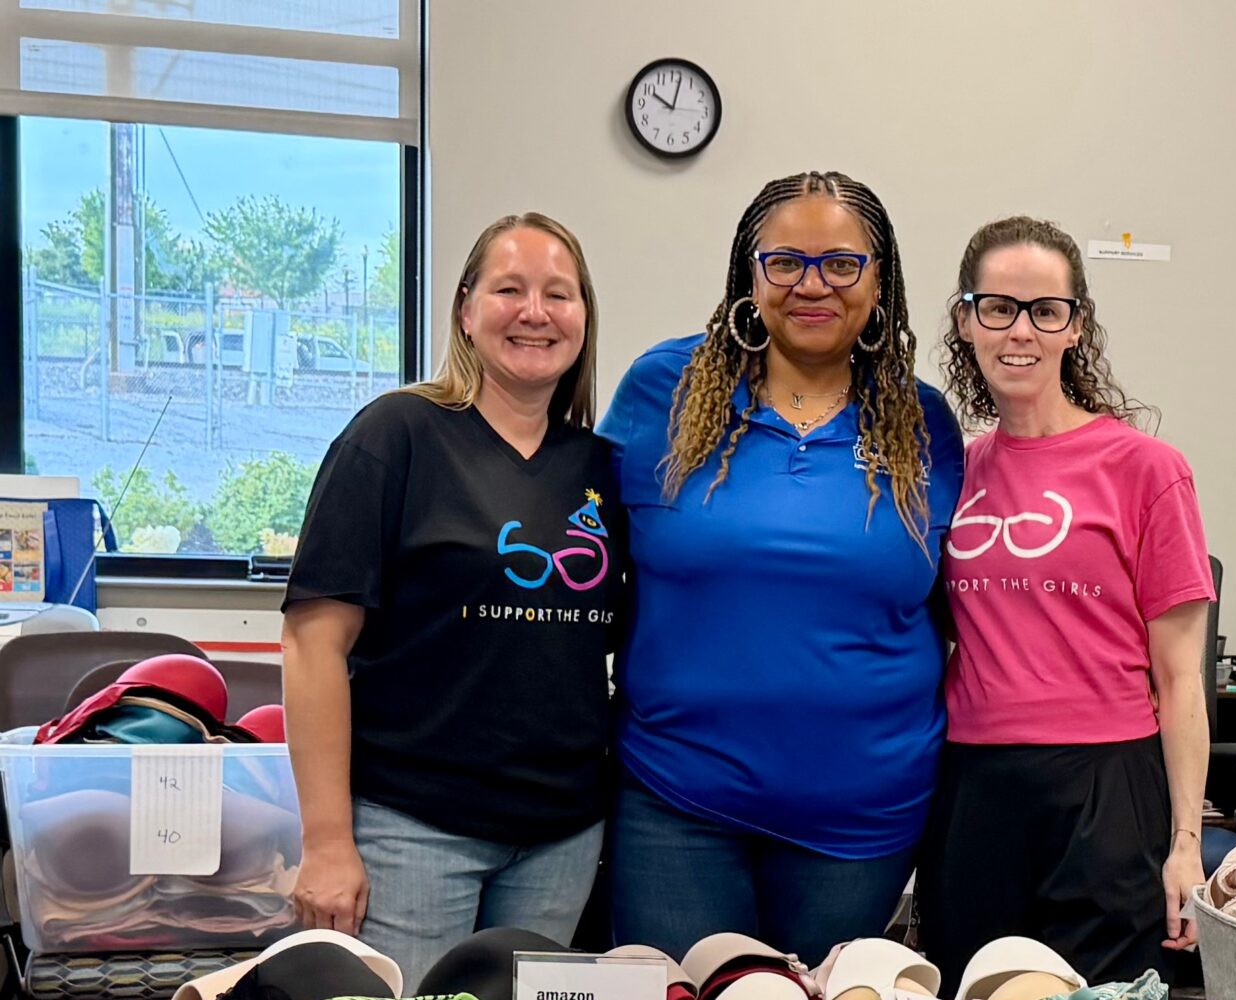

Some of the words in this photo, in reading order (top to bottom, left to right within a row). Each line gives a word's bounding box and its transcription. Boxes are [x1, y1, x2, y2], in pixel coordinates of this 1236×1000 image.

[656, 72, 666, 86] 11
[689, 76, 693, 90] 1
[643, 83, 656, 96] 10
[697, 90, 705, 103] 2
[638, 97, 646, 110] 9
[701, 106, 708, 119] 3
[641, 113, 649, 127] 8
[652, 127, 660, 140] 7
[693, 121, 701, 133] 4
[666, 133, 674, 146] 6
[681, 131, 690, 144] 5
[1001, 577, 1030, 592] THE
[1043, 579, 1102, 598] GIRLS
[461, 605, 467, 619] I
[478, 604, 553, 622] SUPPORT
[556, 608, 580, 622] THE
[159, 775, 181, 791] 42
[157, 828, 181, 844] 40
